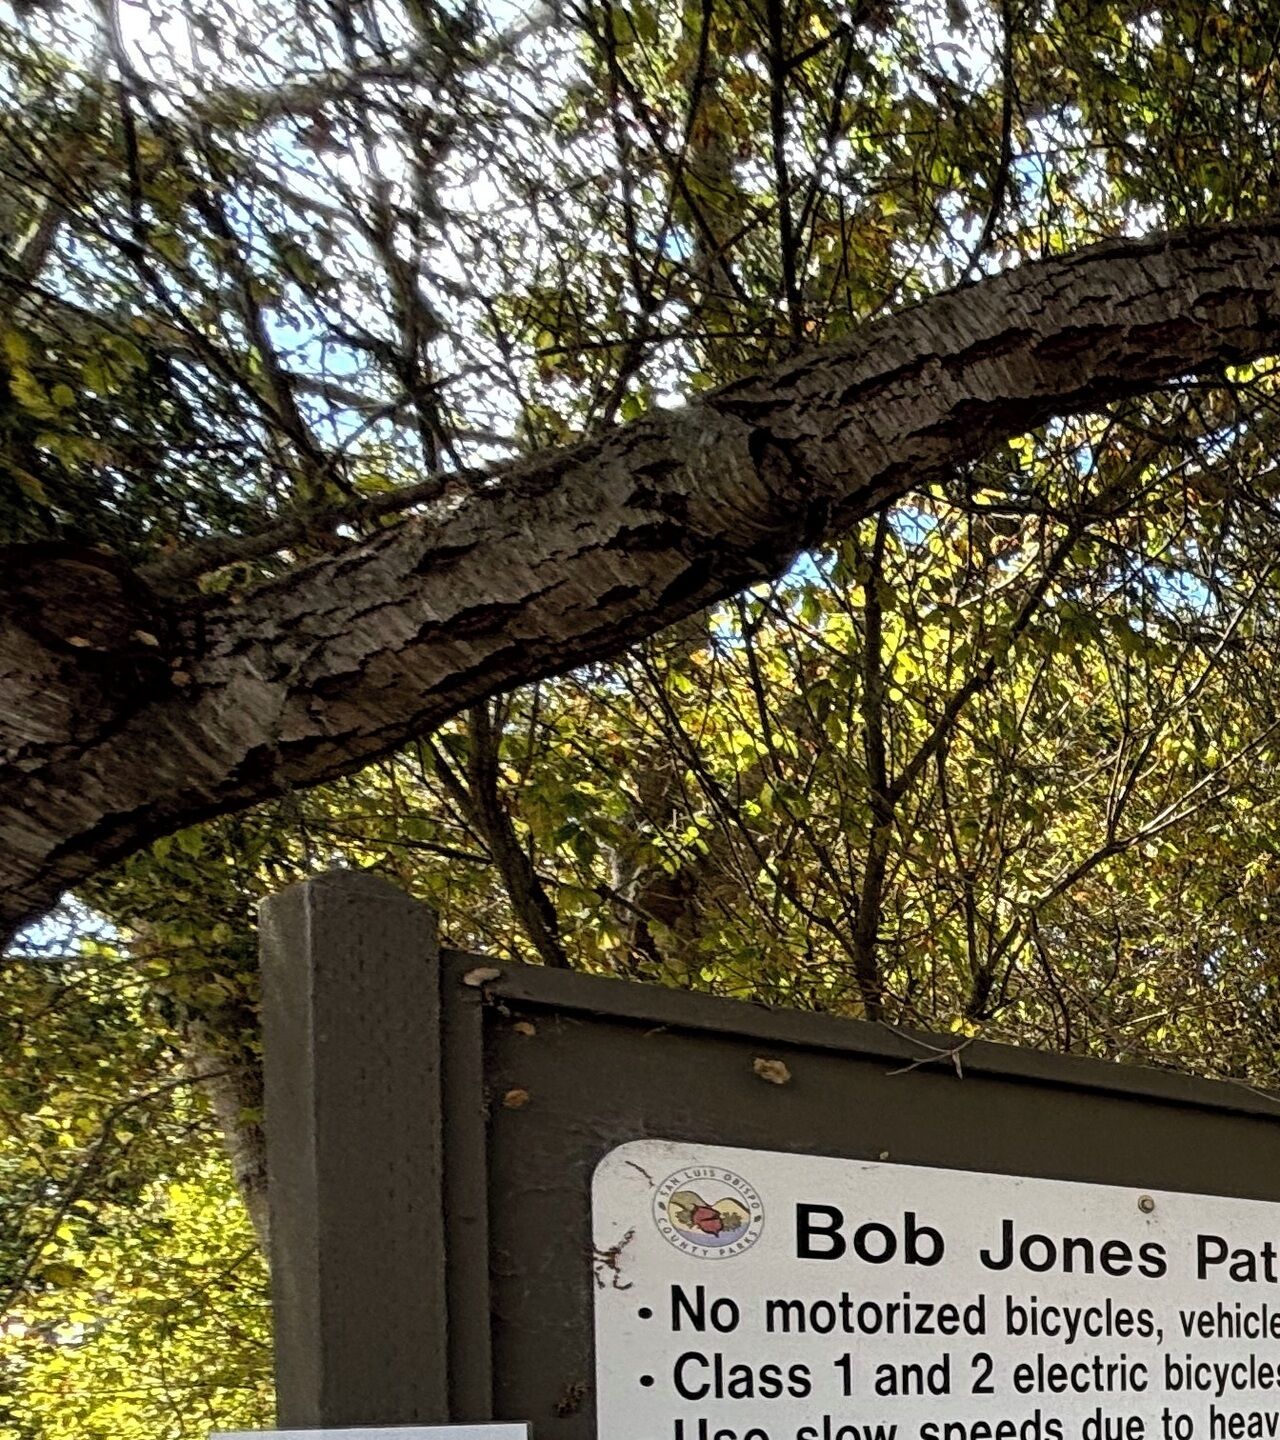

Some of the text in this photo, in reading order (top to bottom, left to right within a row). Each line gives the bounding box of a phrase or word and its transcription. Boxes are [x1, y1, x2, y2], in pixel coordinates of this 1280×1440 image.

[796, 1202, 945, 1267] Bob
[979, 1219, 1167, 1279] Jones
[671, 1284, 740, 1334] No
[766, 1291, 986, 1336] motorized
[1006, 1294, 1165, 1345] bicycles,
[673, 1351, 812, 1401] Class
[834, 1352, 852, 1397] 1
[874, 1352, 950, 1397] and
[971, 1352, 995, 1394] 2
[1013, 1353, 1148, 1394] electric
